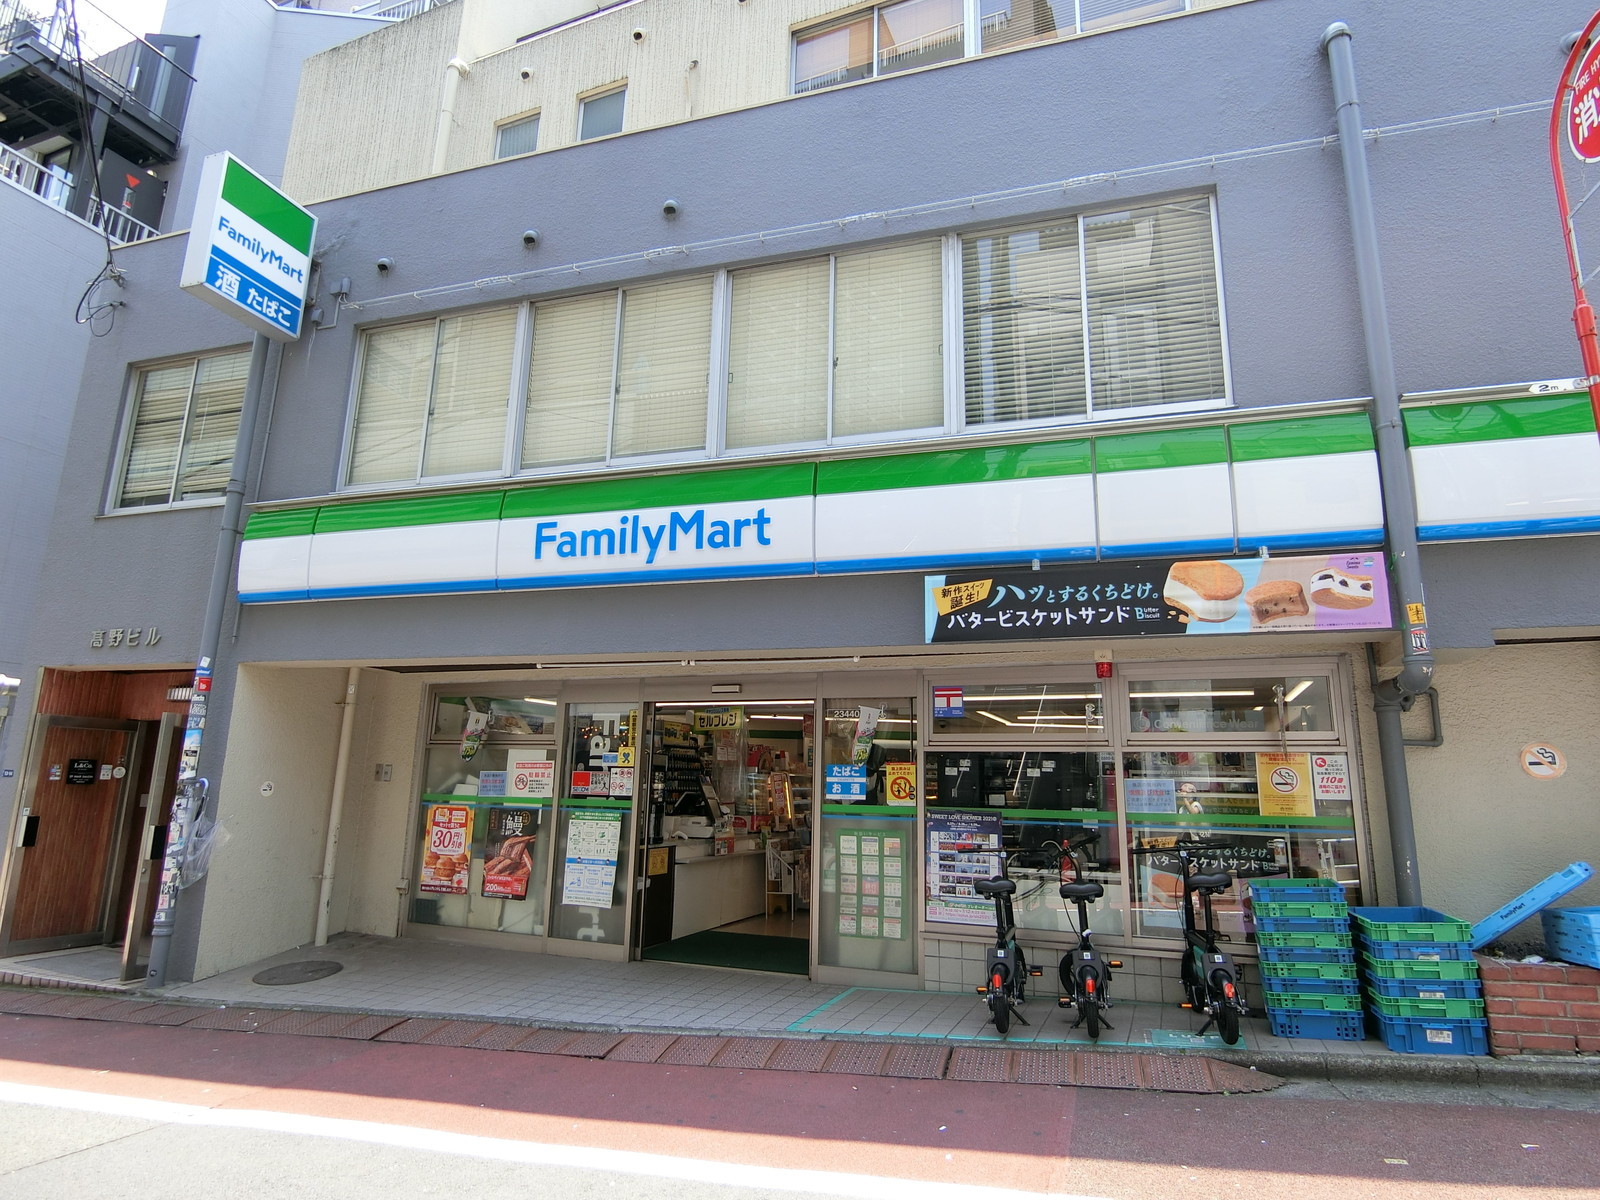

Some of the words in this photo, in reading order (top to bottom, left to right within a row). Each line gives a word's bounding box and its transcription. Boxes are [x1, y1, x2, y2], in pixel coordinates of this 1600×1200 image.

[1575, 69, 1590, 95] FIRE
[218, 215, 304, 284] FamilyMart
[214, 265, 241, 299] 酒
[247, 287, 291, 327] たばこ
[534, 507, 771, 564] FamilyMart
[941, 582, 985, 598] 新作スイーツ
[987, 582, 1158, 608] ハッとするくちどけ。
[947, 605, 1130, 629] バタービスケットサンド
[699, 713, 737, 728] セルフレジ
[1229, 719, 1258, 729] Wear
[832, 766, 860, 776] たばこ
[433, 830, 452, 848] 30
[1147, 855, 1260, 871] バタースケットサンド
[1500, 903, 1526, 920] FamilyMart
